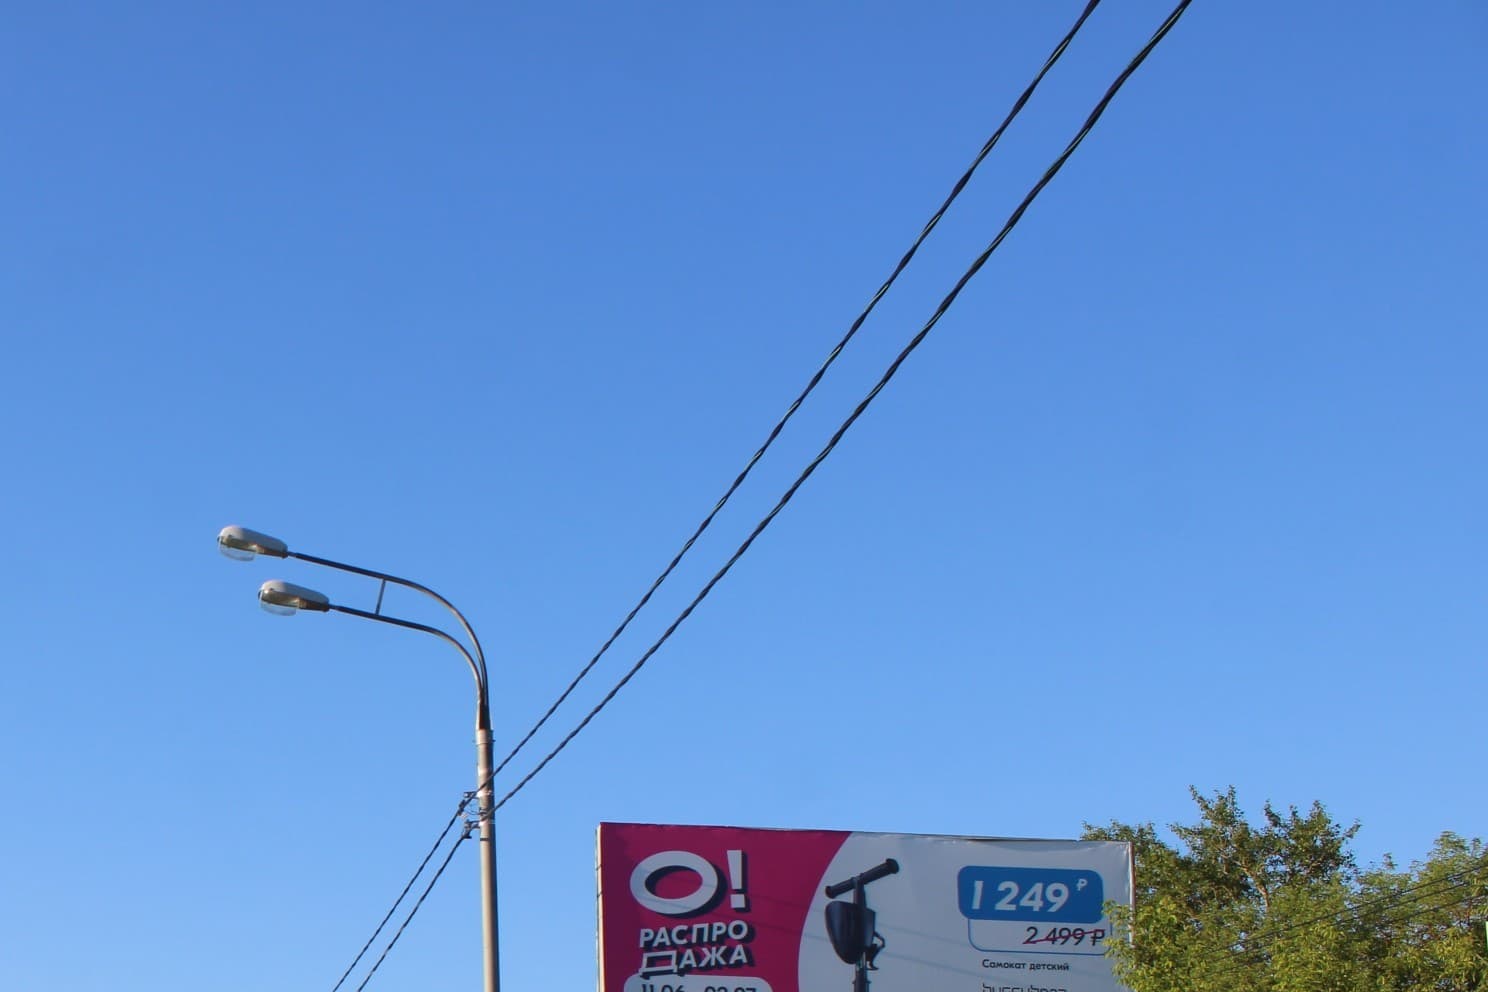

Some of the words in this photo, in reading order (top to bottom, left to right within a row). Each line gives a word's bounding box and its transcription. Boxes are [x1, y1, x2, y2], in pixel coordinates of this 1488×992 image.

[629, 849, 748, 914] О!
[638, 920, 754, 949] РАСПРО
[638, 945, 754, 976] ДАЖА
[982, 959, 1026, 969] Самокат
[1029, 960, 1070, 971] детский
